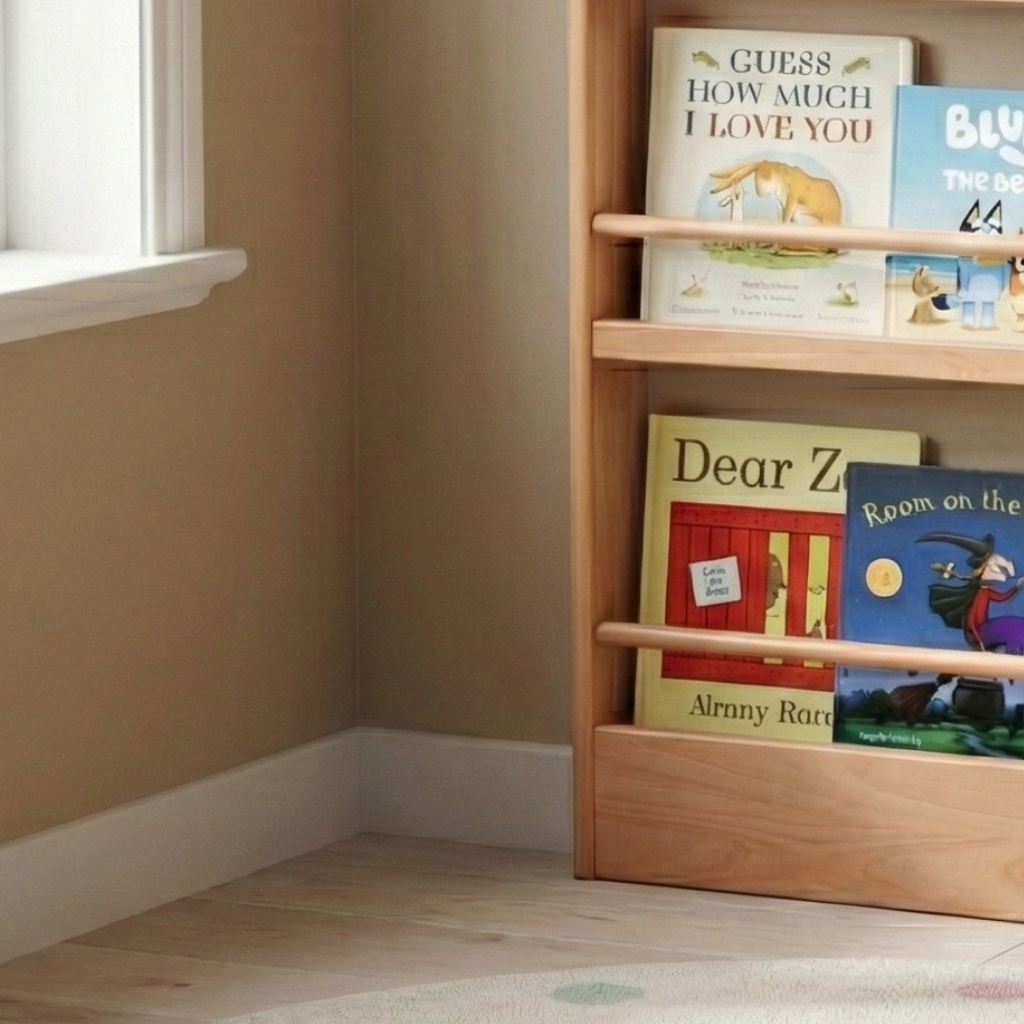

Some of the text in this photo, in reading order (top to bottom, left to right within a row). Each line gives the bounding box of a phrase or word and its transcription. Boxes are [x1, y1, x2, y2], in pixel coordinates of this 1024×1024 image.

[730, 48, 831, 76] GUESS
[687, 79, 872, 109] HOW MUCH
[685, 110, 873, 143] I LOVE YOU
[672, 437, 793, 489] Dear
[862, 497, 935, 527] Room
[943, 493, 975, 510] on
[983, 489, 1021, 515] the
